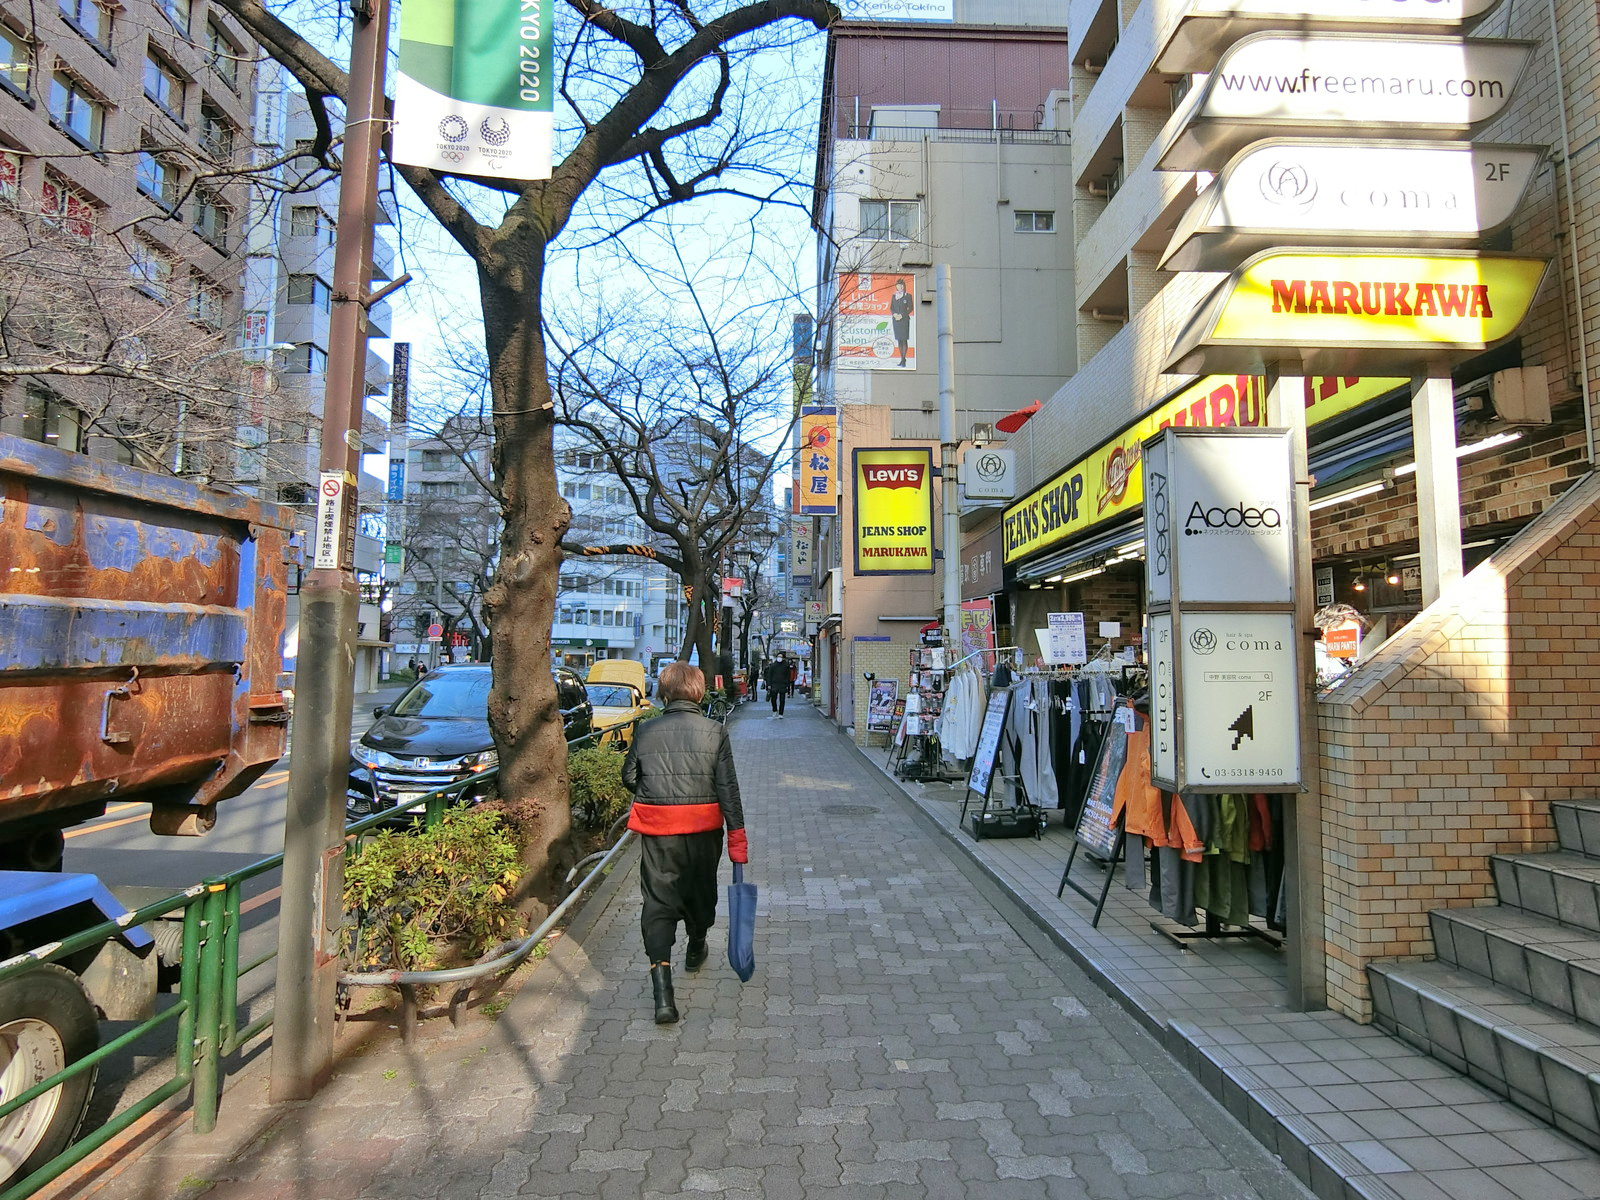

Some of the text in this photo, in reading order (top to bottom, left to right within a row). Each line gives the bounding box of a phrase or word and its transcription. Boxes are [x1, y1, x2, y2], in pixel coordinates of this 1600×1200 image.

[905, 2, 946, 12] Tokina
[519, 45, 541, 102] 2020
[1221, 68, 1504, 99] www.freemaru.com
[1483, 162, 1511, 182] 2F
[1340, 188, 1459, 211] coma
[1270, 279, 1494, 319] MARUKAWA
[840, 335, 867, 345] Salon
[808, 453, 830, 494] 松屋
[1004, 500, 1039, 560] JEANS
[1041, 472, 1084, 535] SHOP
[1153, 472, 1169, 576] Acdea
[1185, 501, 1281, 528] Acdea
[862, 526, 927, 538] JEANS SHOP
[862, 547, 928, 557] MARUKAWA
[1159, 629, 1168, 643] 2F
[1226, 640, 1282, 651] coma
[1258, 690, 1272, 701] 2F
[1158, 660, 1168, 753] coma
[1214, 768, 1283, 777] 03-5318-9450
